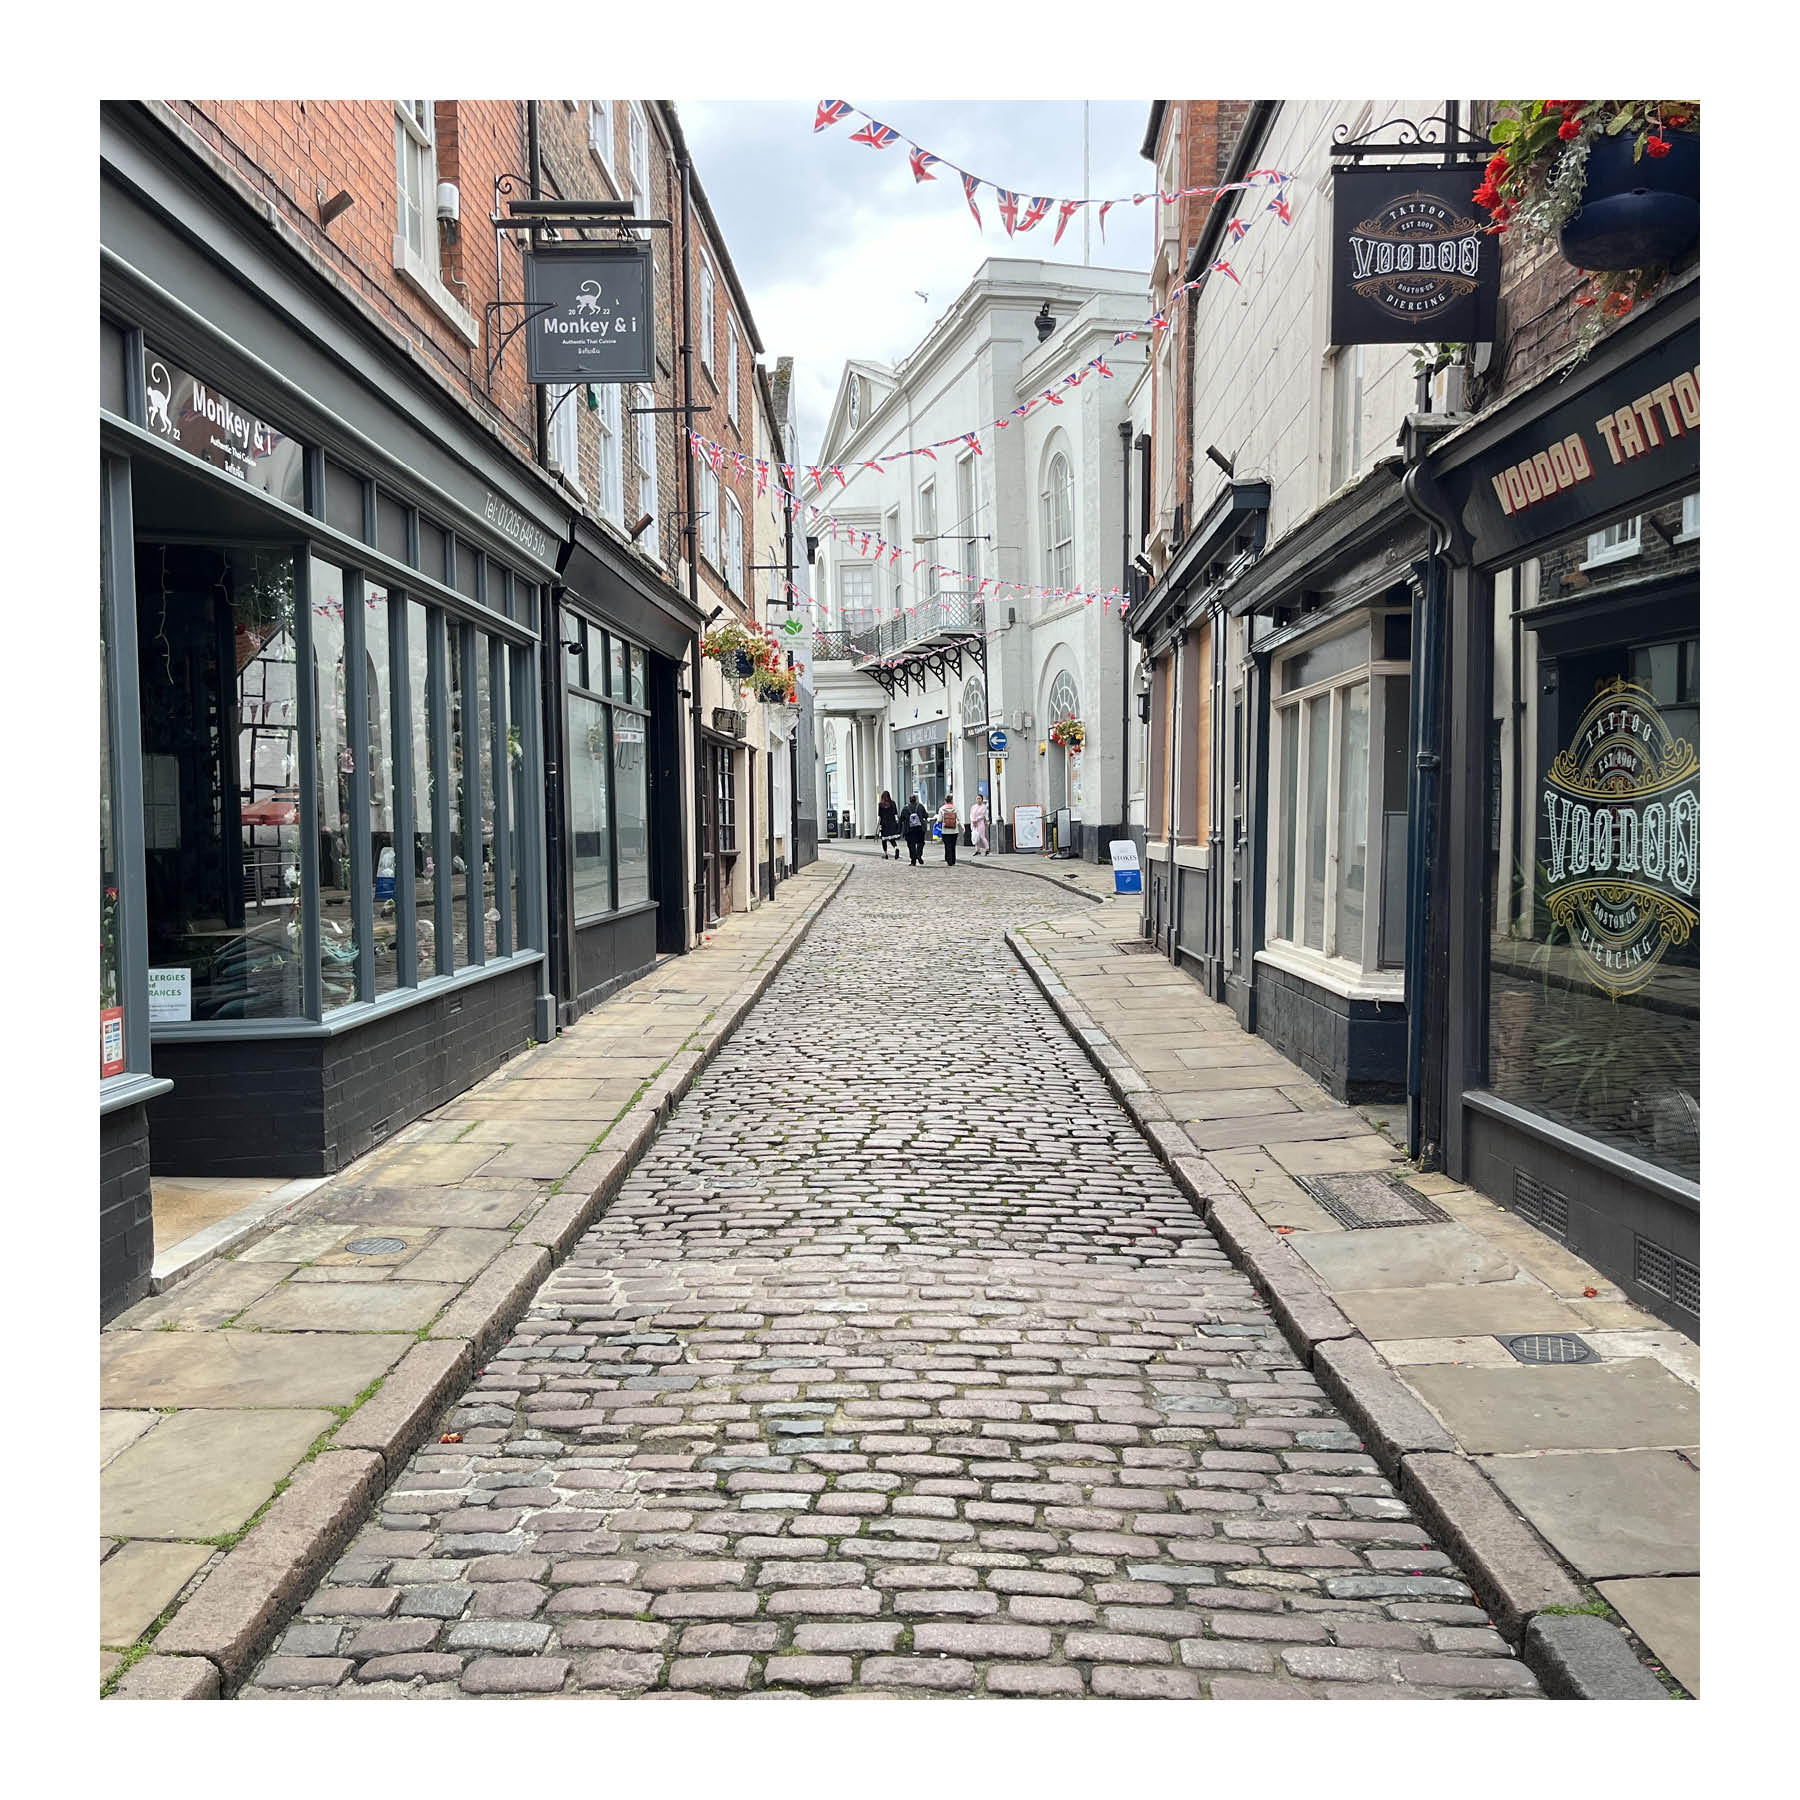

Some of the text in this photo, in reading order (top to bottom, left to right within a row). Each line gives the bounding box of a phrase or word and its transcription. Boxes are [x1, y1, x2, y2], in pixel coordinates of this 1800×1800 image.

[1389, 204, 1446, 220] TATTOO
[1401, 221, 1414, 231] EST
[1349, 236, 1481, 279] VOODOO
[1386, 293, 1446, 311] PIERCING
[544, 317, 636, 337] Monkey & i
[172, 428, 181, 441] 22
[192, 380, 250, 449] Monkey
[253, 420, 265, 451] &
[1491, 364, 1700, 517] VOODOO TATTO
[484, 491, 546, 556] Tel: 01205 648 516
[1585, 710, 1653, 750] TATTOO
[1598, 752, 1613, 774] EST
[1543, 789, 1700, 896] VOODOO
[1580, 927, 1653, 970] PIERCING
